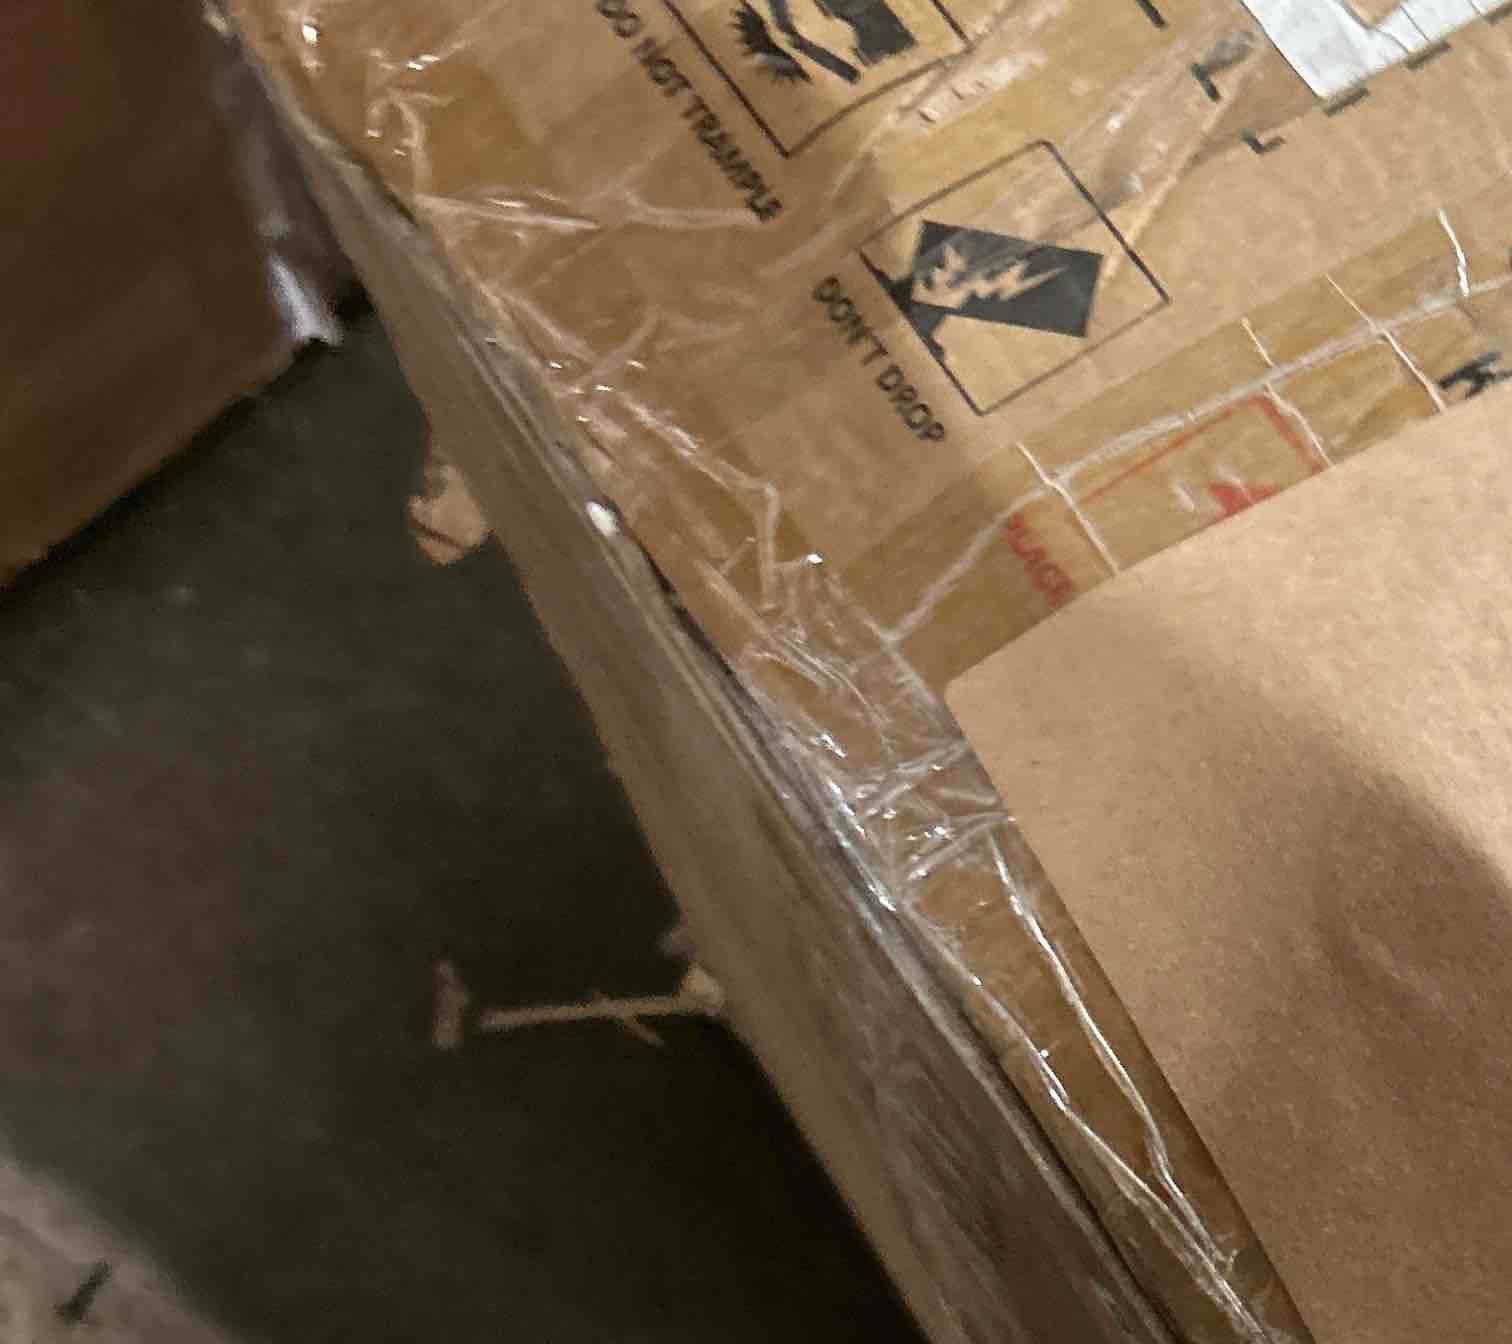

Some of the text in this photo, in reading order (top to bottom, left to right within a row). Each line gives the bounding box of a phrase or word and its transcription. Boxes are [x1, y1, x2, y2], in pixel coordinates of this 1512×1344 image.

[630, 36, 692, 98] NOT
[680, 94, 784, 224] TRAMPLE
[811, 275, 946, 442] DON'T DROP
